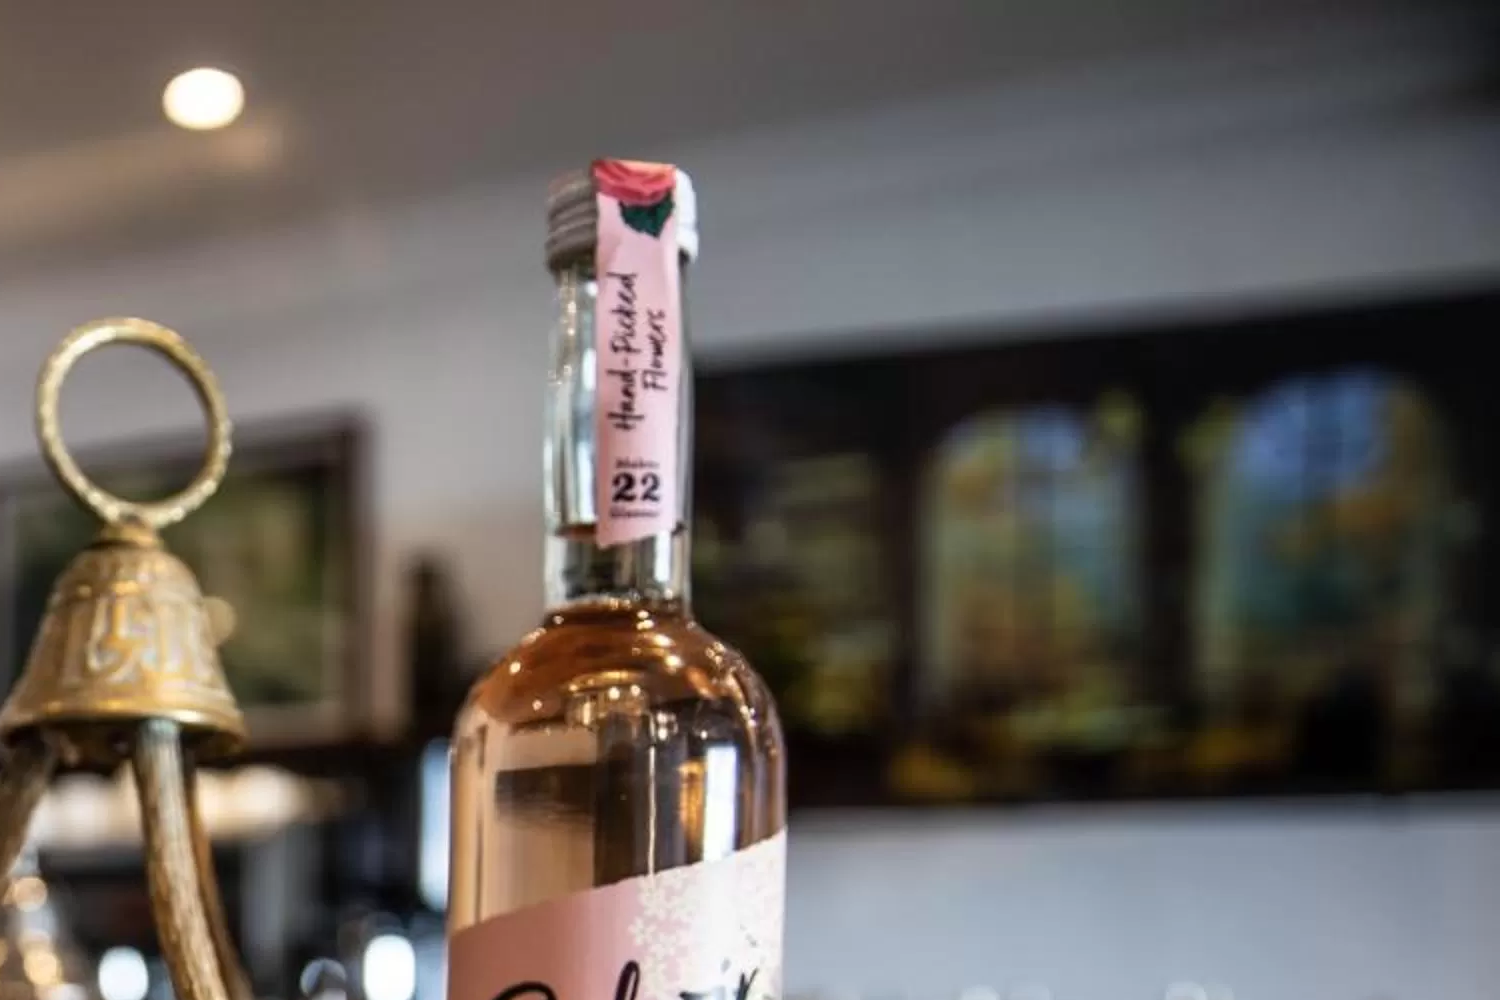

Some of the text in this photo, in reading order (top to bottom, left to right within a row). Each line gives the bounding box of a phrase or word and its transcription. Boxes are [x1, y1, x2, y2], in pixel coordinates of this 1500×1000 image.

[606, 271, 645, 431] Hand-Picked
[642, 309, 668, 390] Flowers
[611, 471, 661, 503] 22
